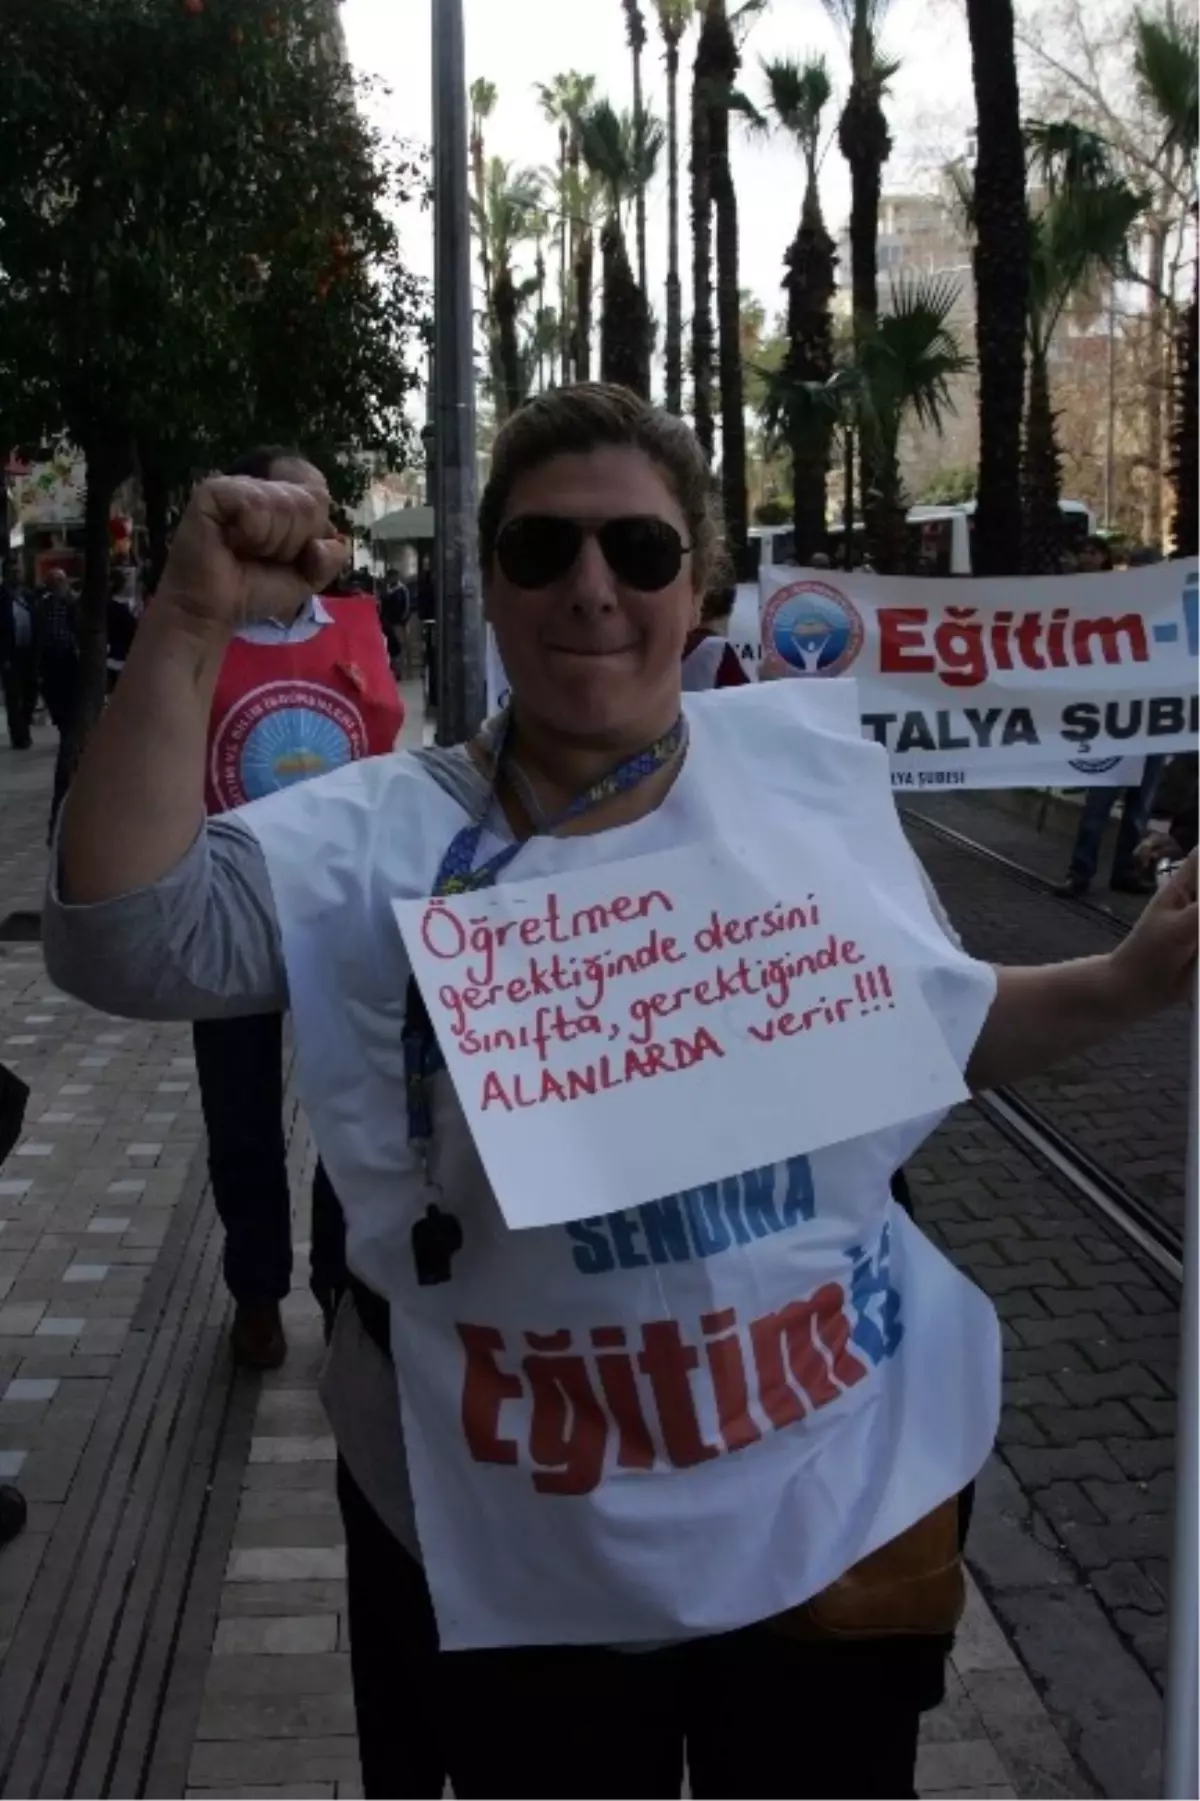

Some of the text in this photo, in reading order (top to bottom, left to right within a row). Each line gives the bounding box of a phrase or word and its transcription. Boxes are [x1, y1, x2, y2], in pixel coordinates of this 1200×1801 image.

[421, 889, 674, 986] Öğretmen
[438, 892, 820, 1036] gerektiğinde dersini
[457, 933, 866, 1061] sınıfta, gerektiğinde
[480, 963, 896, 1113] ALANLARDA verir!!!
[455, 1281, 868, 1496] Eğitim
